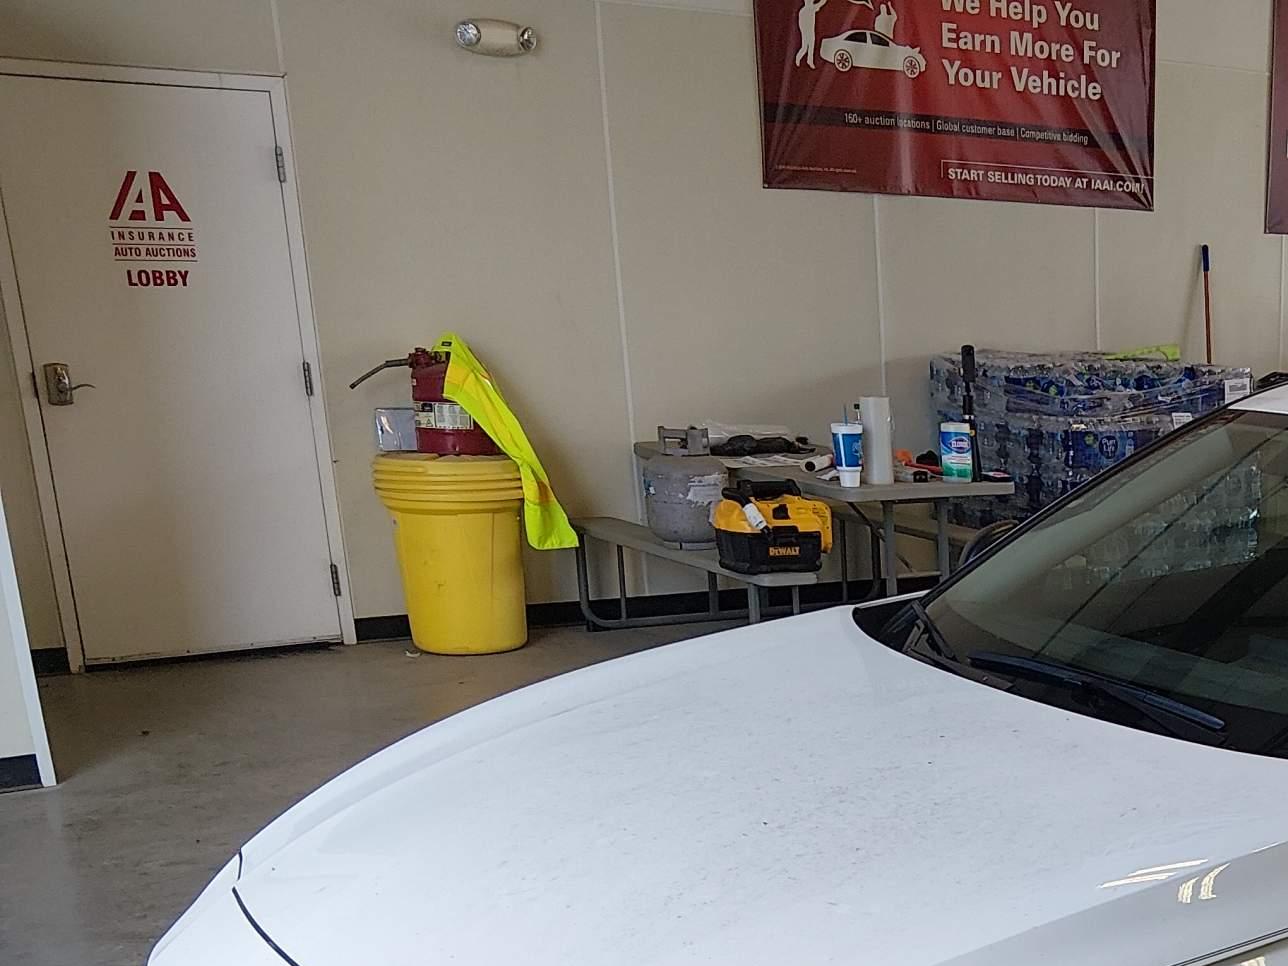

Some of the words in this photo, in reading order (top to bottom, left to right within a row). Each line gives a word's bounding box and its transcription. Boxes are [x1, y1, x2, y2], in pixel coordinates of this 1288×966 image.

[989, 0, 1047, 28] Help
[1055, 1, 1099, 30] You
[941, 22, 1000, 53] Earn
[1010, 31, 1074, 62] More
[1083, 40, 1121, 68] For
[942, 59, 1002, 88] Your
[1010, 66, 1102, 100] Vehicle
[864, 115, 895, 126] auction
[936, 120, 960, 132] Global
[961, 124, 995, 135] customer
[997, 125, 1015, 137] base
[1020, 128, 1060, 141] Competitive
[1062, 131, 1088, 145] bidding
[948, 168, 985, 181] START
[987, 170, 1034, 185] SELLING
[1036, 175, 1071, 188] TODAY
[1074, 178, 1088, 189] AT
[111, 230, 195, 242] INSURANCE
[114, 247, 142, 257] AUTO
[145, 247, 197, 258] AUCTIONS
[126, 269, 190, 287] LOBBY
